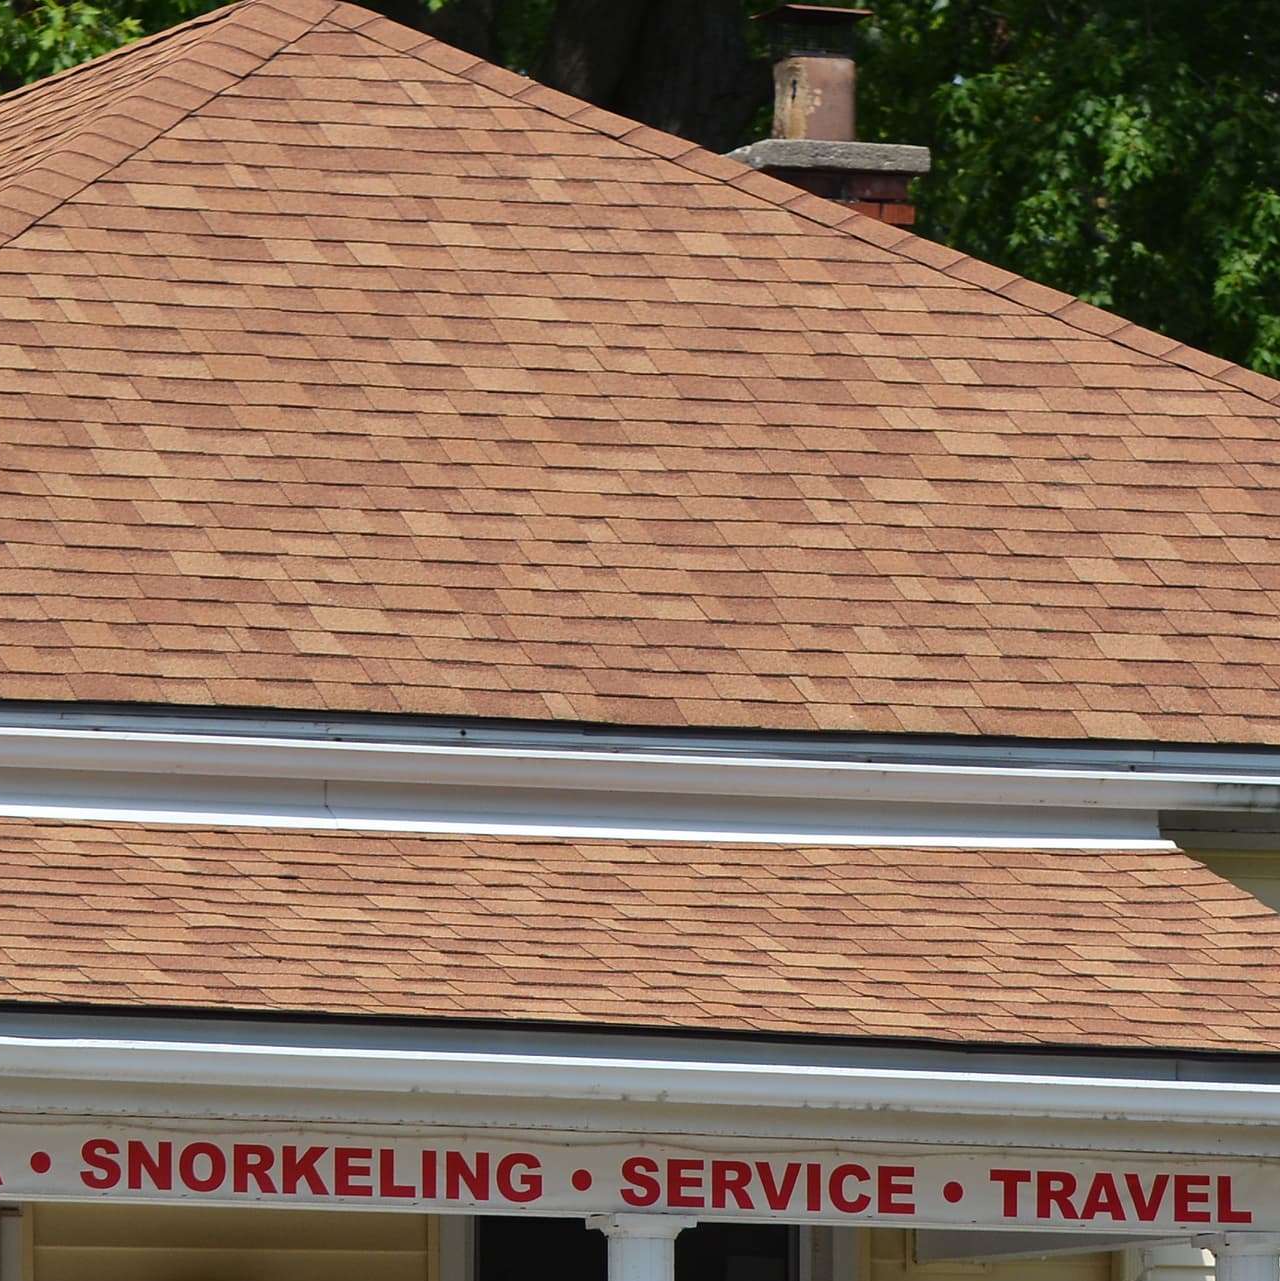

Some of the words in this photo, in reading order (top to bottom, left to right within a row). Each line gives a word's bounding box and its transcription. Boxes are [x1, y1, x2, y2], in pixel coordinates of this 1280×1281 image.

[80, 1138, 544, 1203] SNORKELING
[621, 1156, 916, 1216] SERVICE
[990, 1168, 1253, 1224] TRAVEL
